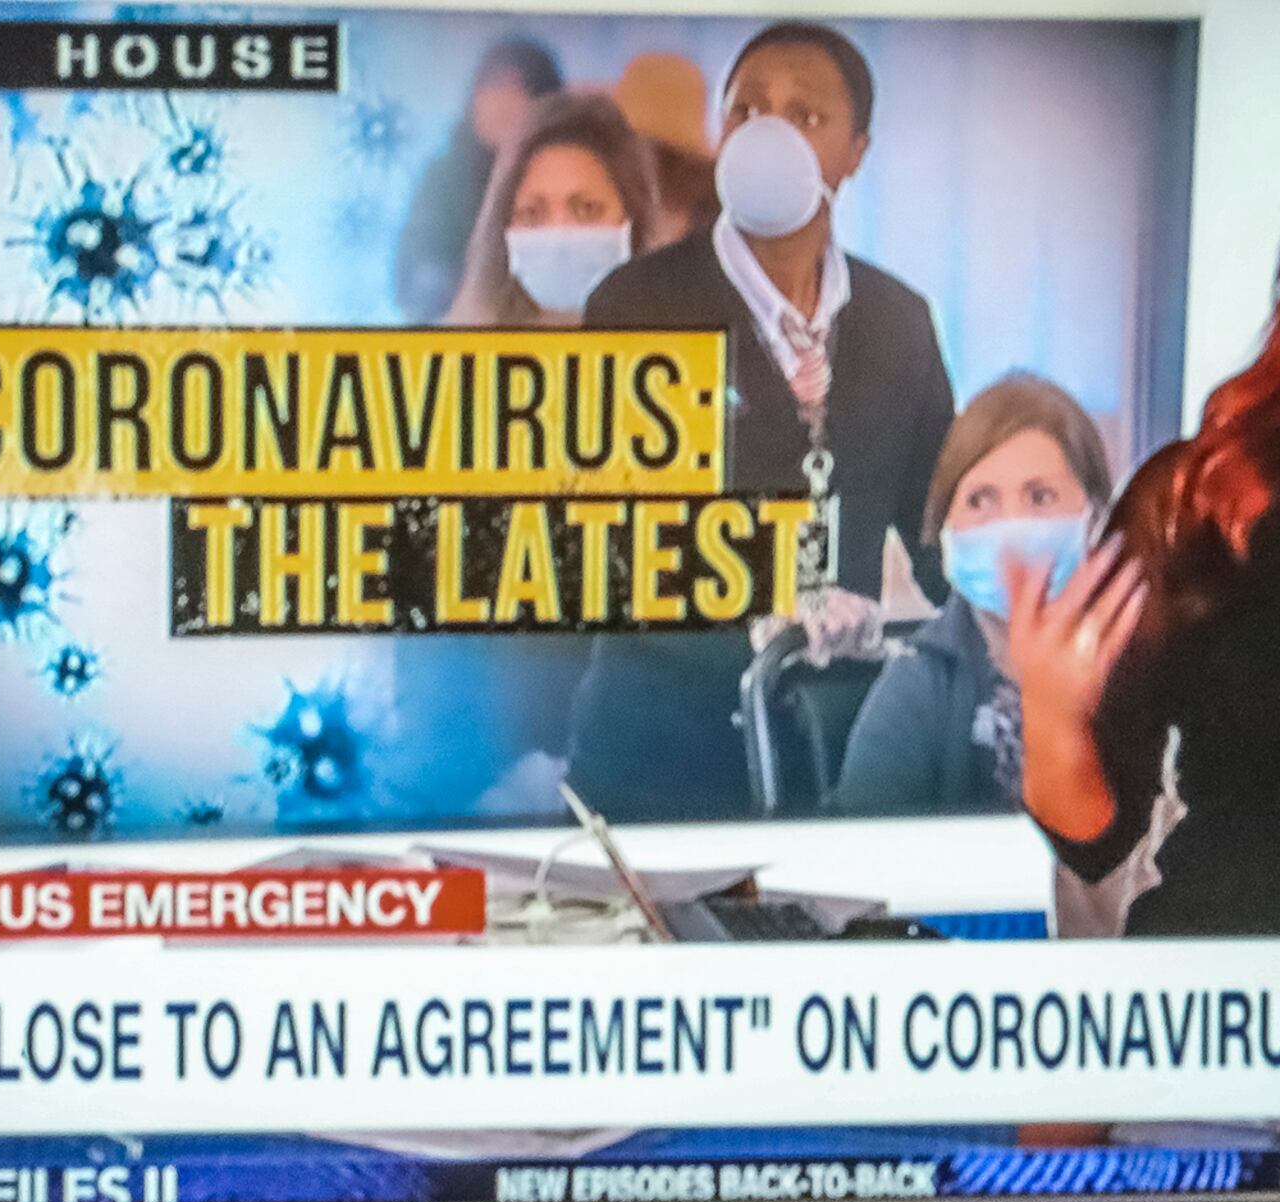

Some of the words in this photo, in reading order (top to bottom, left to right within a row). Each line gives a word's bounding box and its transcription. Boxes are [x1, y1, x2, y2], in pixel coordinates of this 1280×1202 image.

[57, 34, 328, 80] HOUSE
[187, 501, 393, 627] THE
[434, 499, 815, 623] LATEST
[88, 879, 444, 929] EMERGENCY
[165, 1000, 242, 1080] TO
[266, 1001, 347, 1078] AN
[372, 996, 771, 1078] AGREEMENT"
[796, 993, 877, 1073] ON
[494, 1165, 568, 1202] NEW
[571, 1164, 716, 1201] EPISODES
[720, 1161, 938, 1200] BACK-TO-BACK
